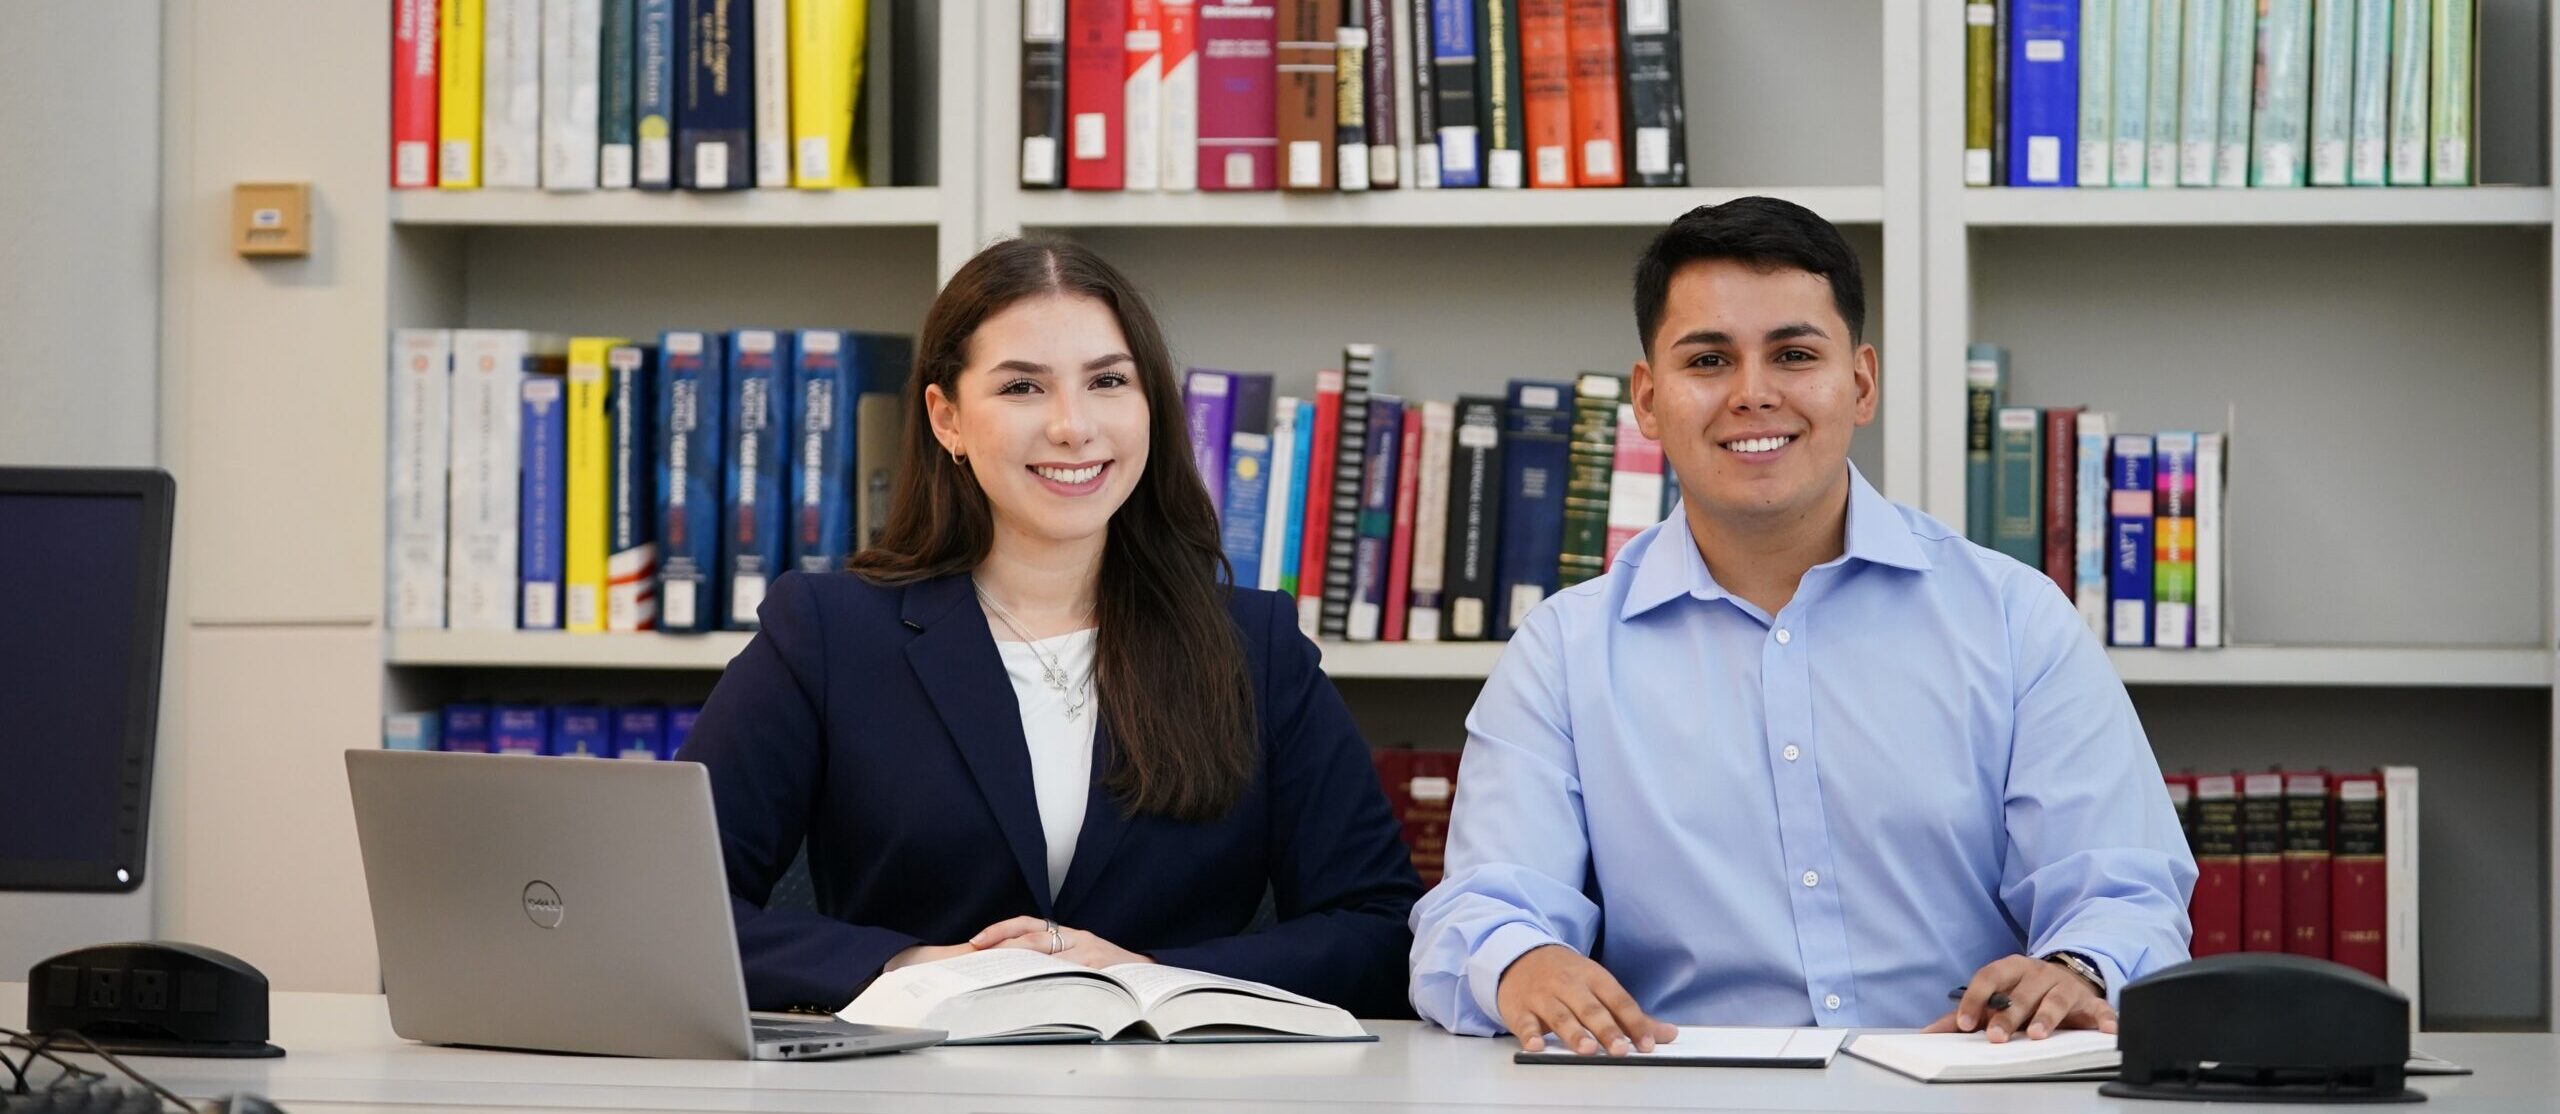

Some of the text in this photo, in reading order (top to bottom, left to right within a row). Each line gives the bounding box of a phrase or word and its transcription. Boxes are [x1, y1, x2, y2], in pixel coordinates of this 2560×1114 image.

[671, 378, 687, 431] WORLD
[741, 377, 756, 429] WORLD
[805, 377, 821, 430] WORLD
[670, 432, 687, 467] YEAR
[739, 431, 757, 467] YEAR
[804, 432, 822, 467] YEAR
[2119, 521, 2143, 575] Law
[527, 898, 560, 911] DELL
